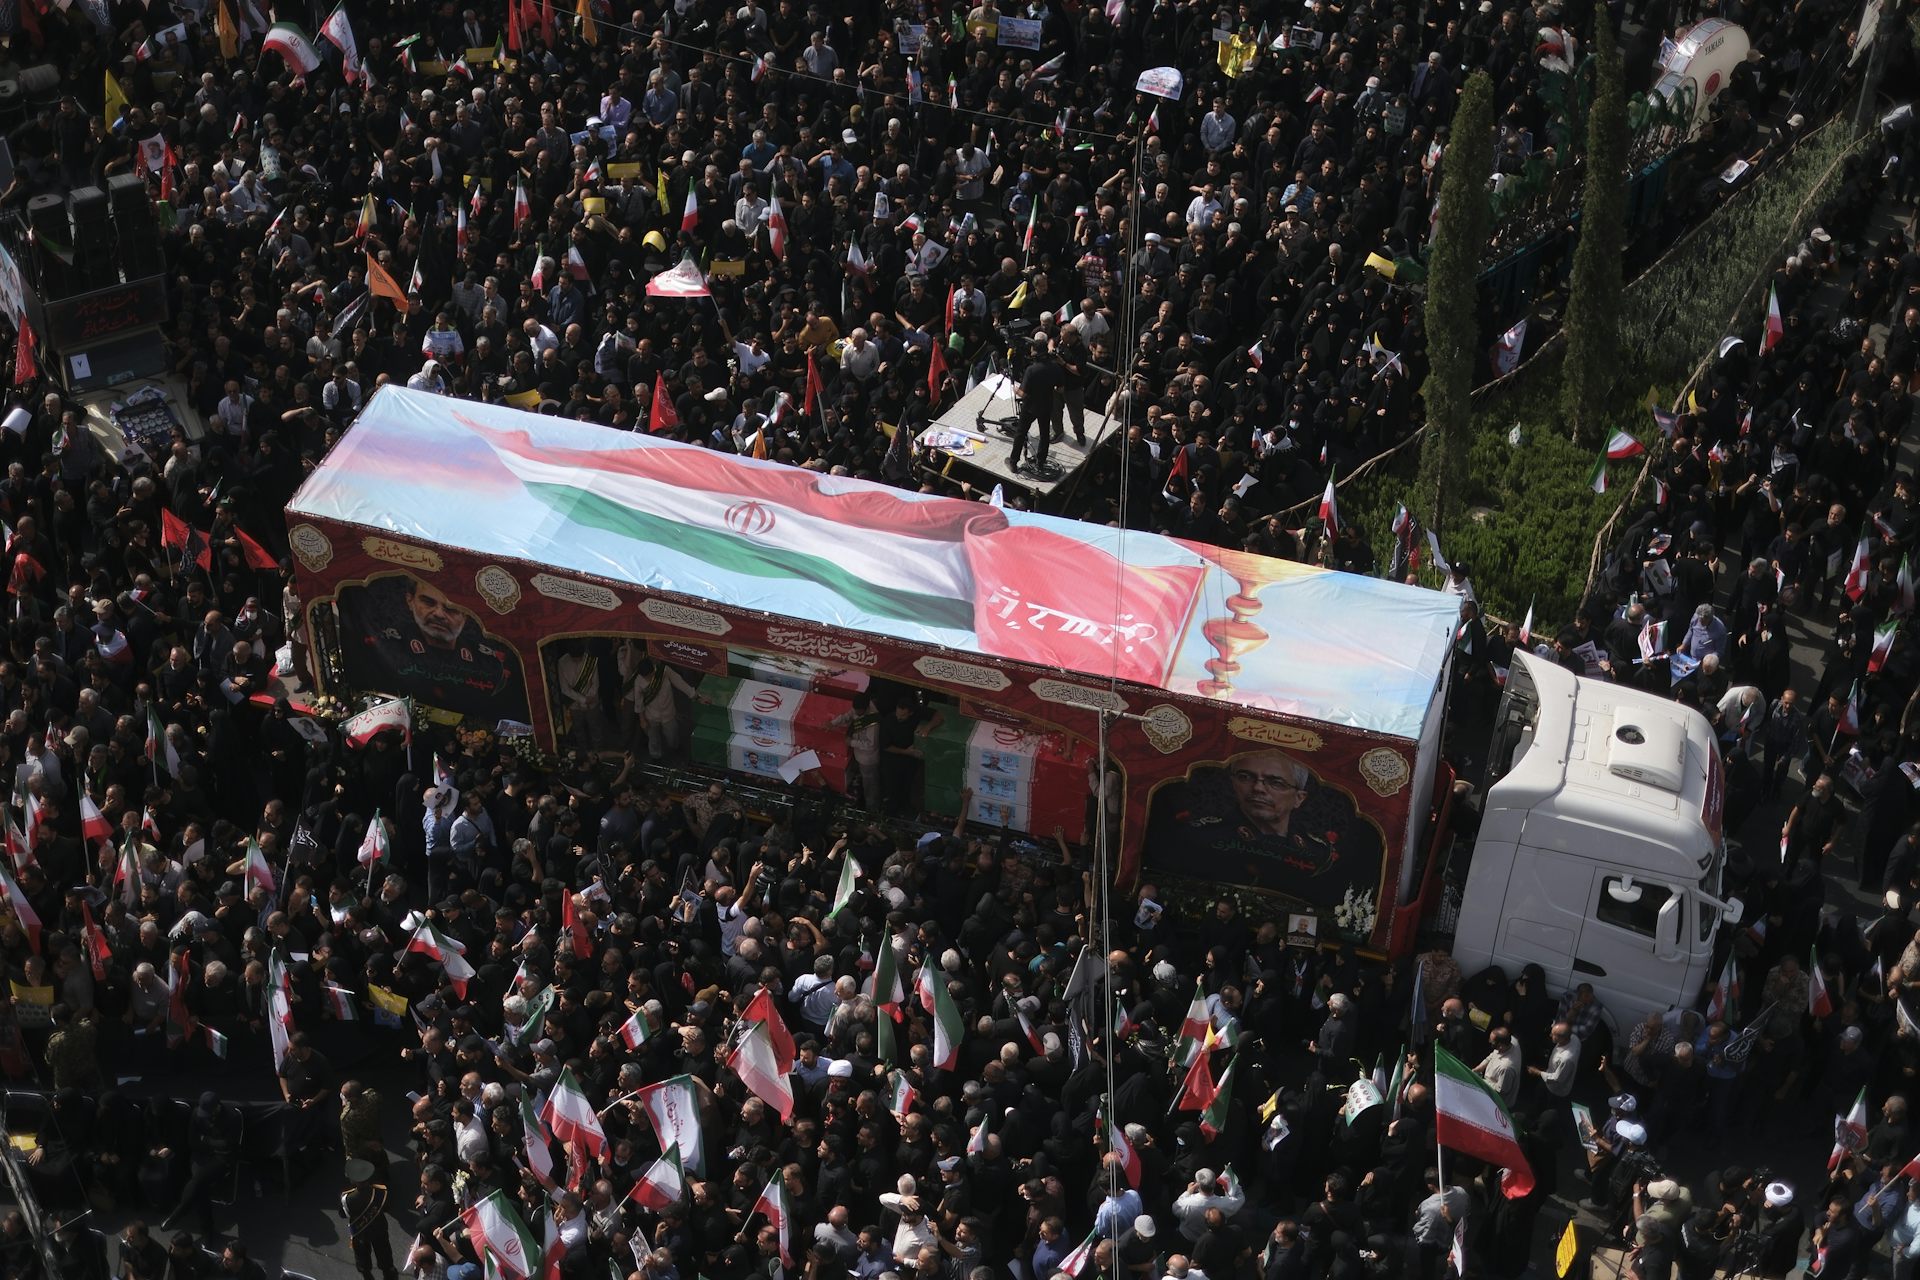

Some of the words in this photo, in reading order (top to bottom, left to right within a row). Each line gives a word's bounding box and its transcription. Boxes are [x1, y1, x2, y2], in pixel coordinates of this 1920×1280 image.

[1704, 36, 1725, 56] YAMAHA
[1026, 602, 1158, 653] حسین
[848, 649, 878, 666] ایران
[433, 671, 464, 685] مهدی
[464, 677, 494, 691] شهید
[1247, 848, 1281, 860] محمد
[1284, 855, 1317, 872] شهید
